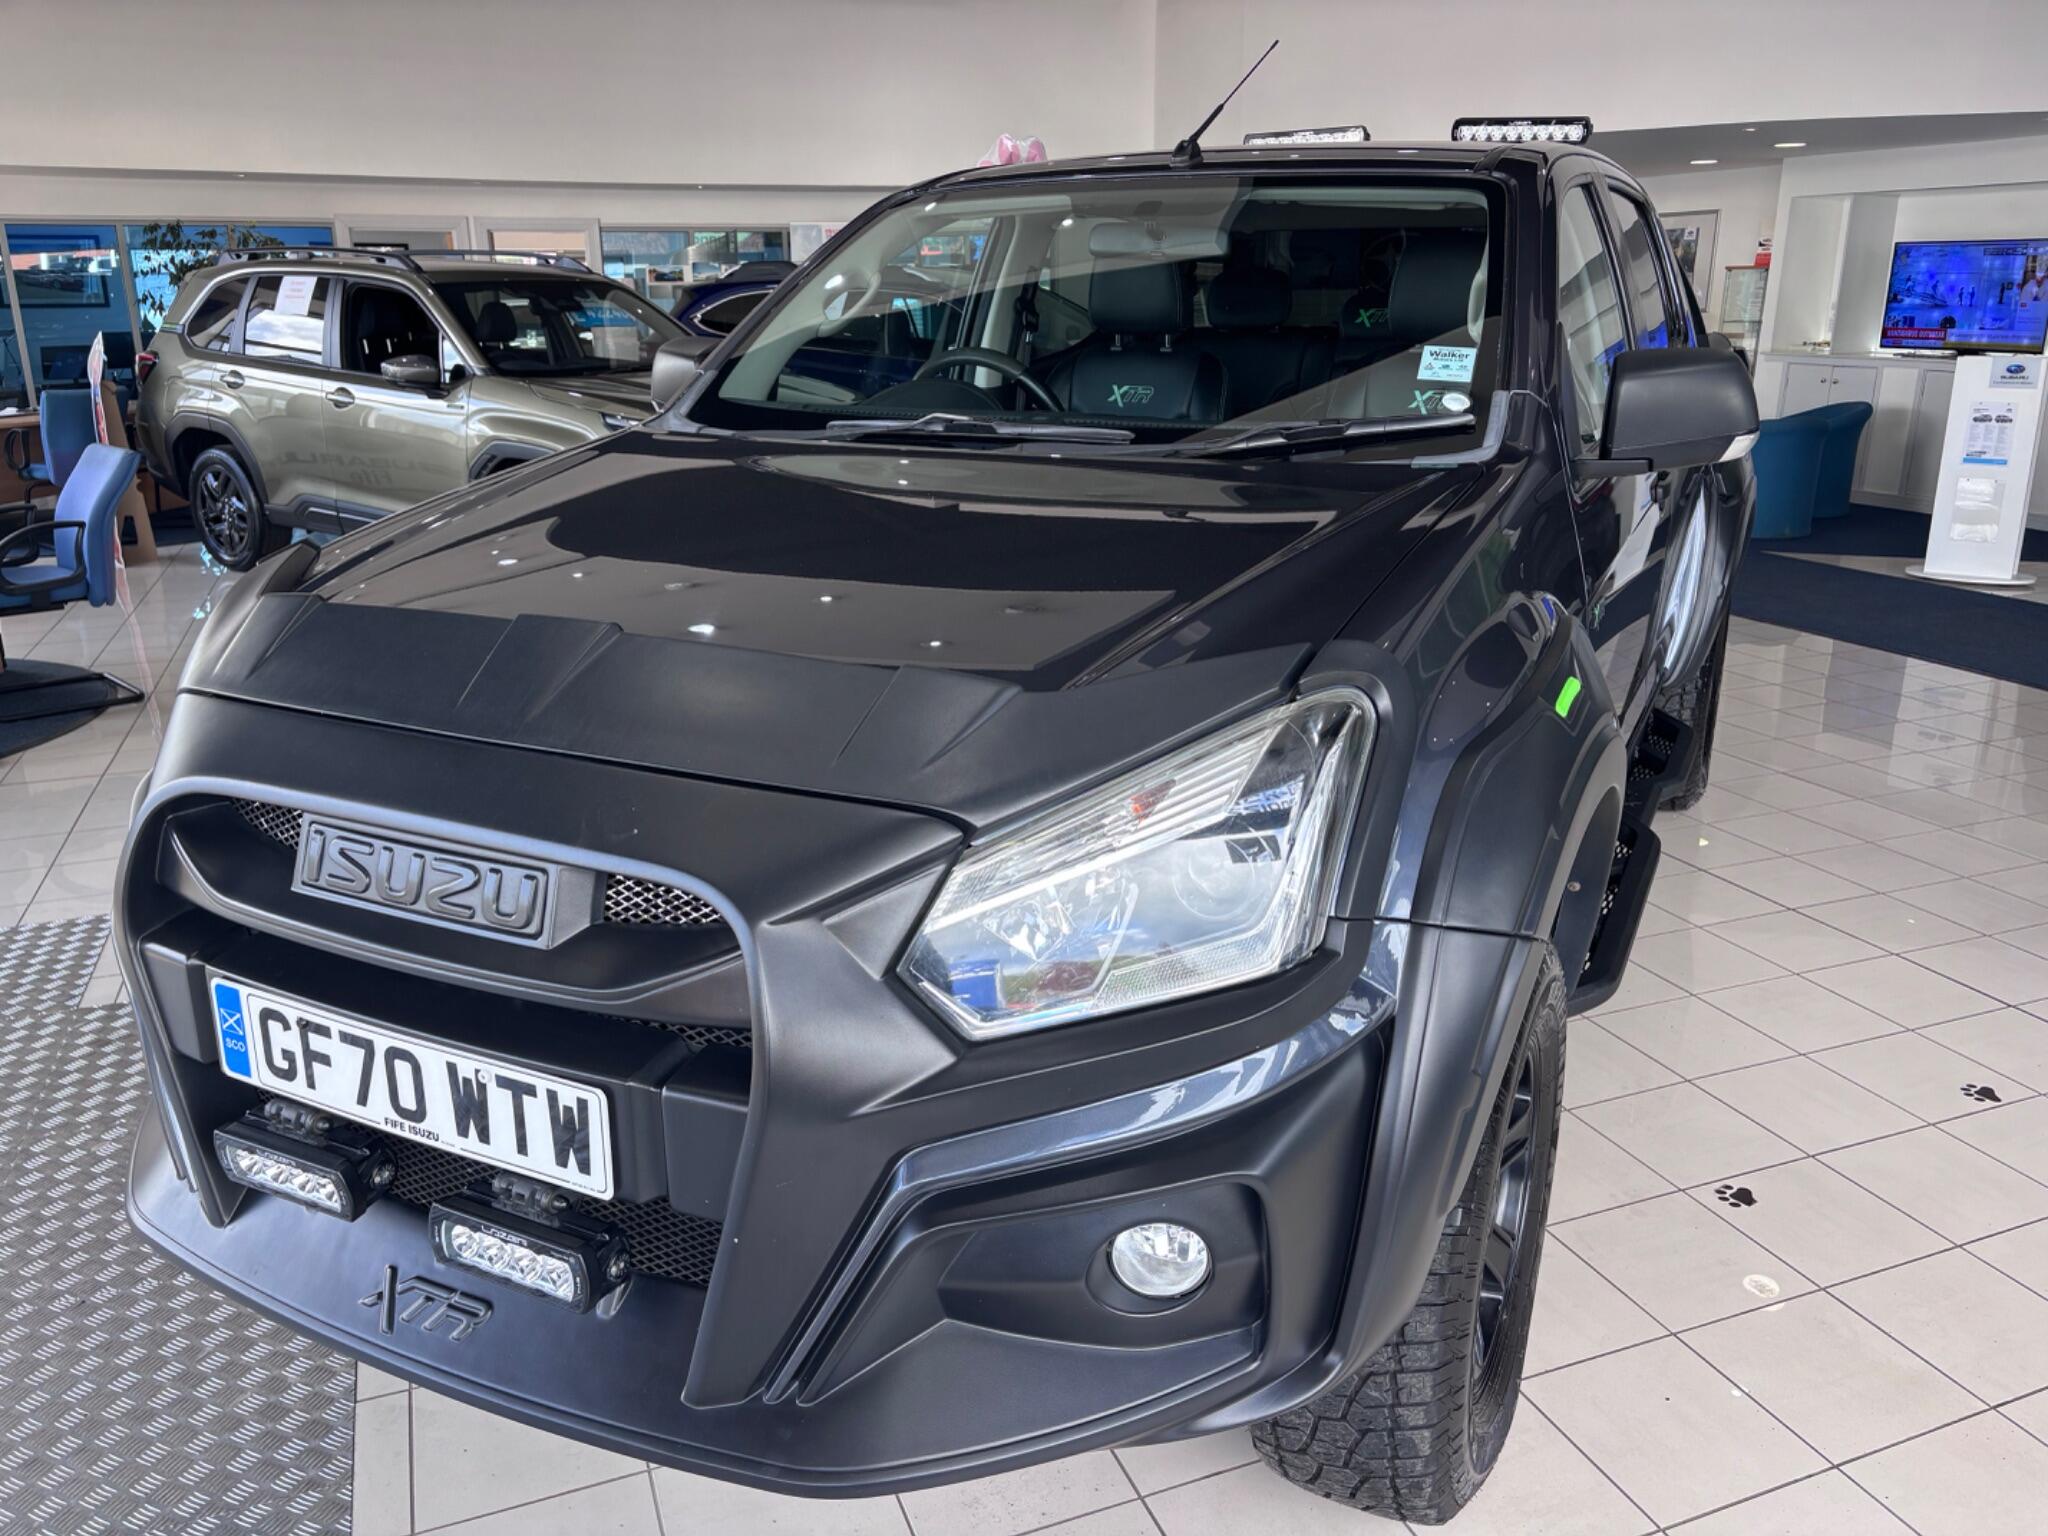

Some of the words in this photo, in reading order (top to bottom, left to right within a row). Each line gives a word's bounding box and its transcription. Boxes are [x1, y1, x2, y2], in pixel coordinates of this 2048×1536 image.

[1429, 350, 1471, 359] Walker
[1107, 384, 1154, 408] XTR
[1408, 390, 1443, 415] XT
[303, 829, 538, 930] ISUZU
[225, 1038, 246, 1053] SCO
[259, 1007, 427, 1124] GF70
[446, 1060, 591, 1177] WTW
[384, 1117, 406, 1132] FIFE
[408, 1123, 440, 1142] ISUZU
[358, 1264, 494, 1342] XTR
